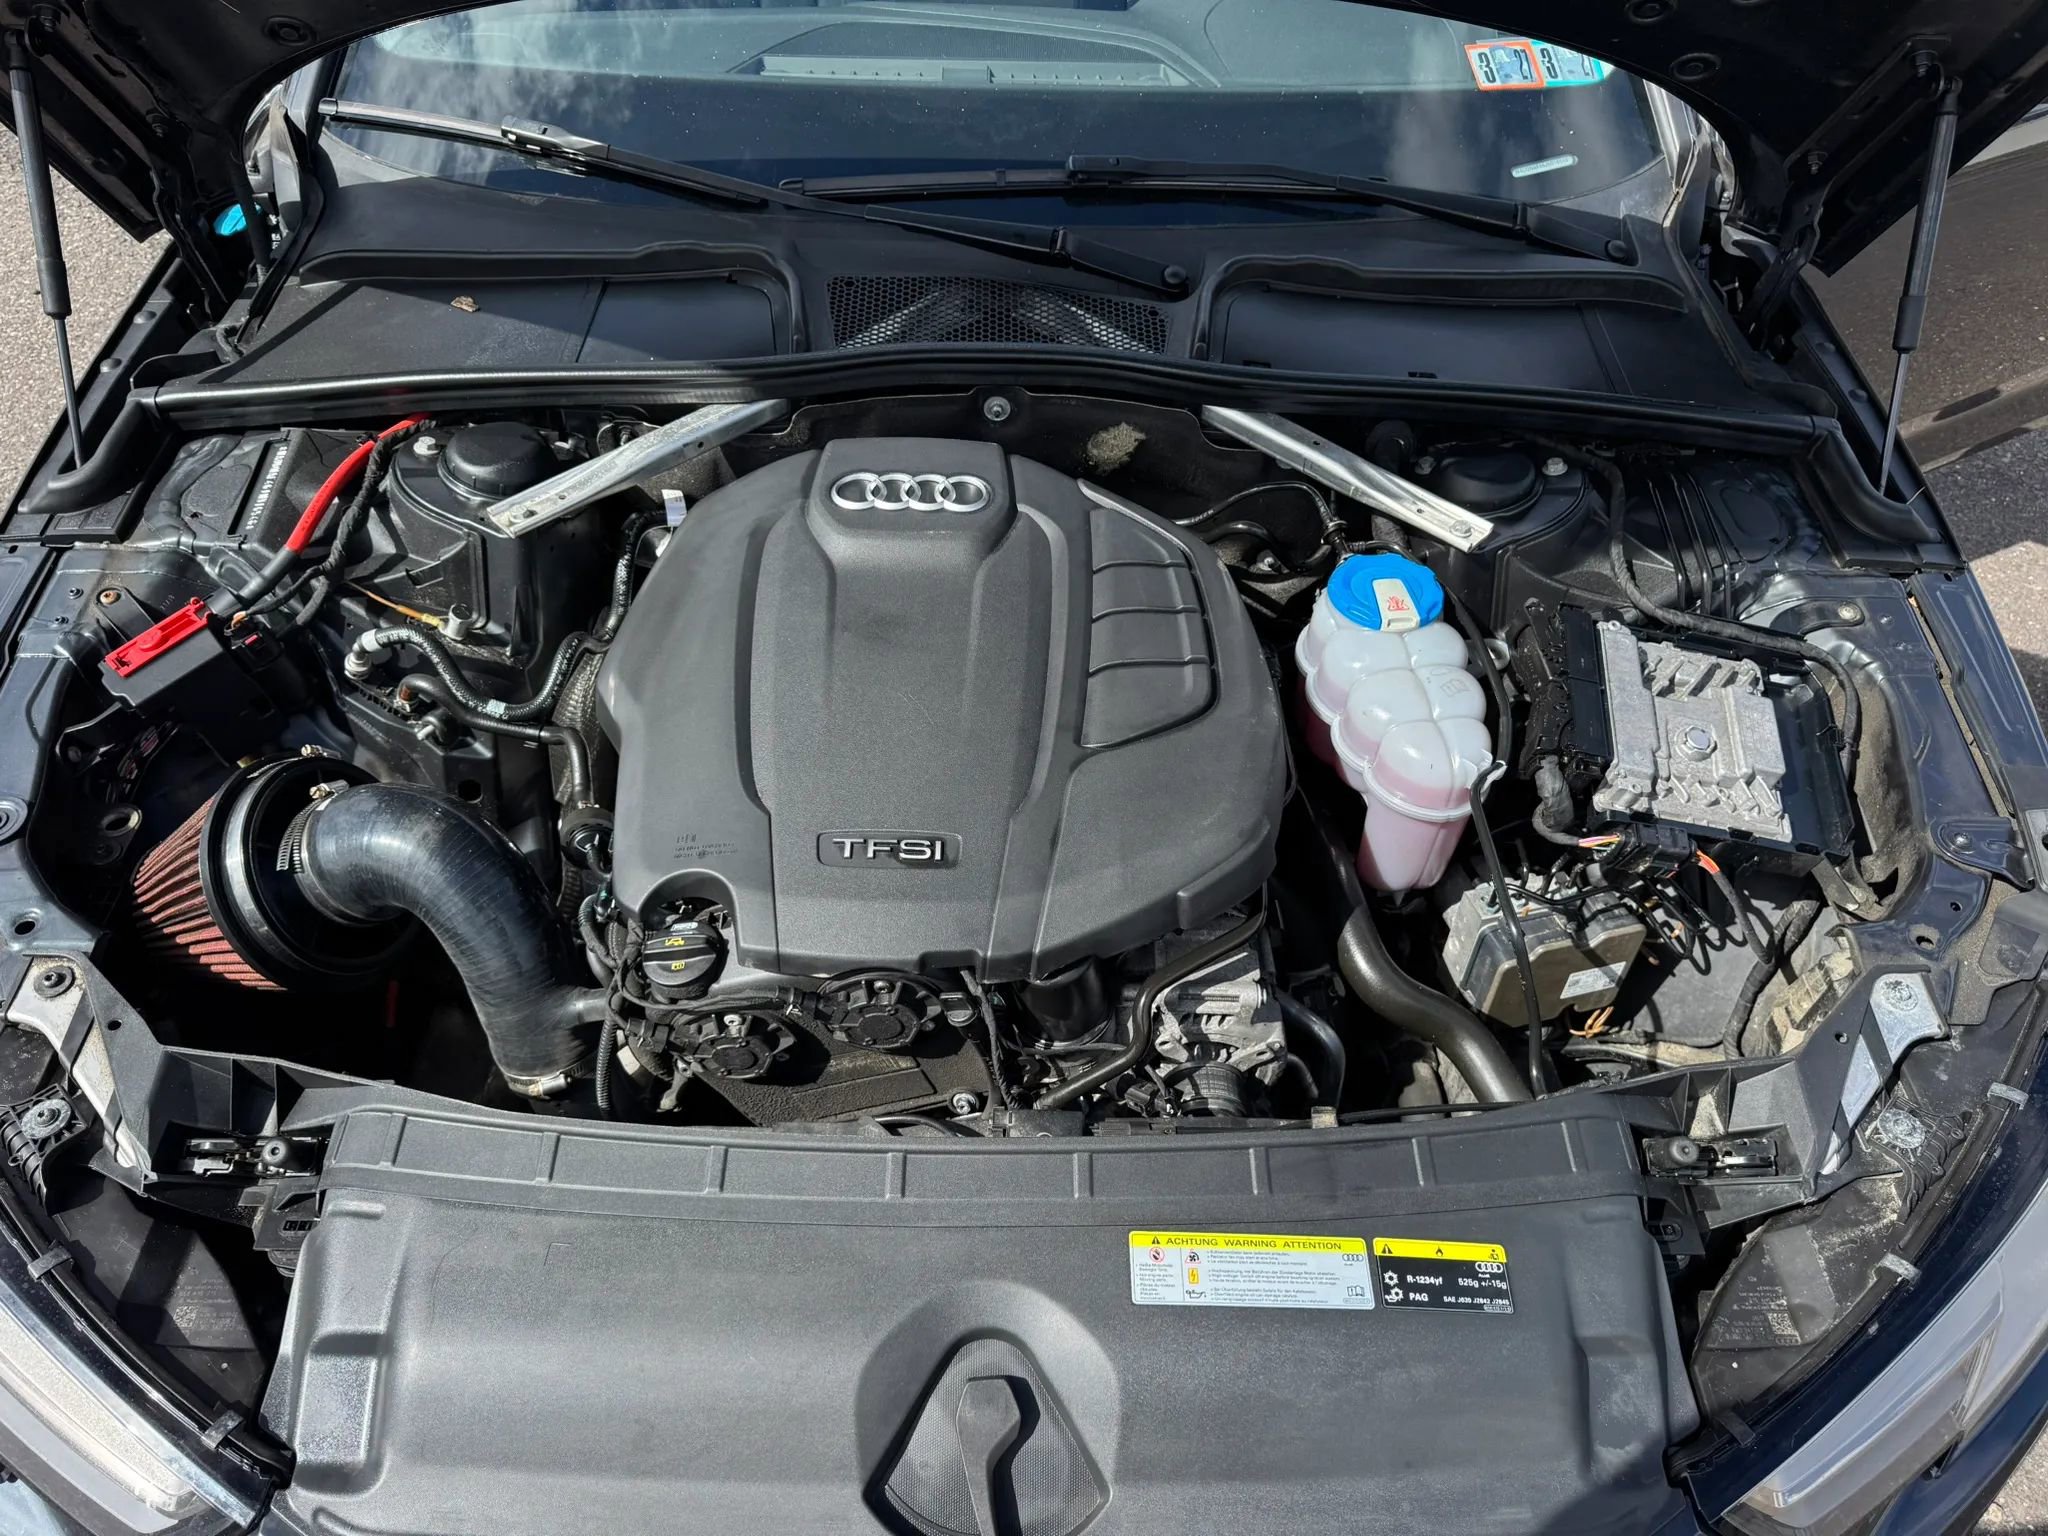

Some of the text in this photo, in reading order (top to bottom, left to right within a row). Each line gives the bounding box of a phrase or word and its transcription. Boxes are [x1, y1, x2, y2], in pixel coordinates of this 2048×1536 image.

[1478, 48, 1534, 84] 3 27
[1540, 48, 1558, 79] 3
[832, 838, 942, 861] TFSI
[1166, 1237, 1342, 1250] ACHTUNG WARNING ATTENTION
[1406, 1275, 1443, 1286] R-1234yf
[1458, 1278, 1479, 1289] 525g
[1409, 1293, 1429, 1302] PAG
